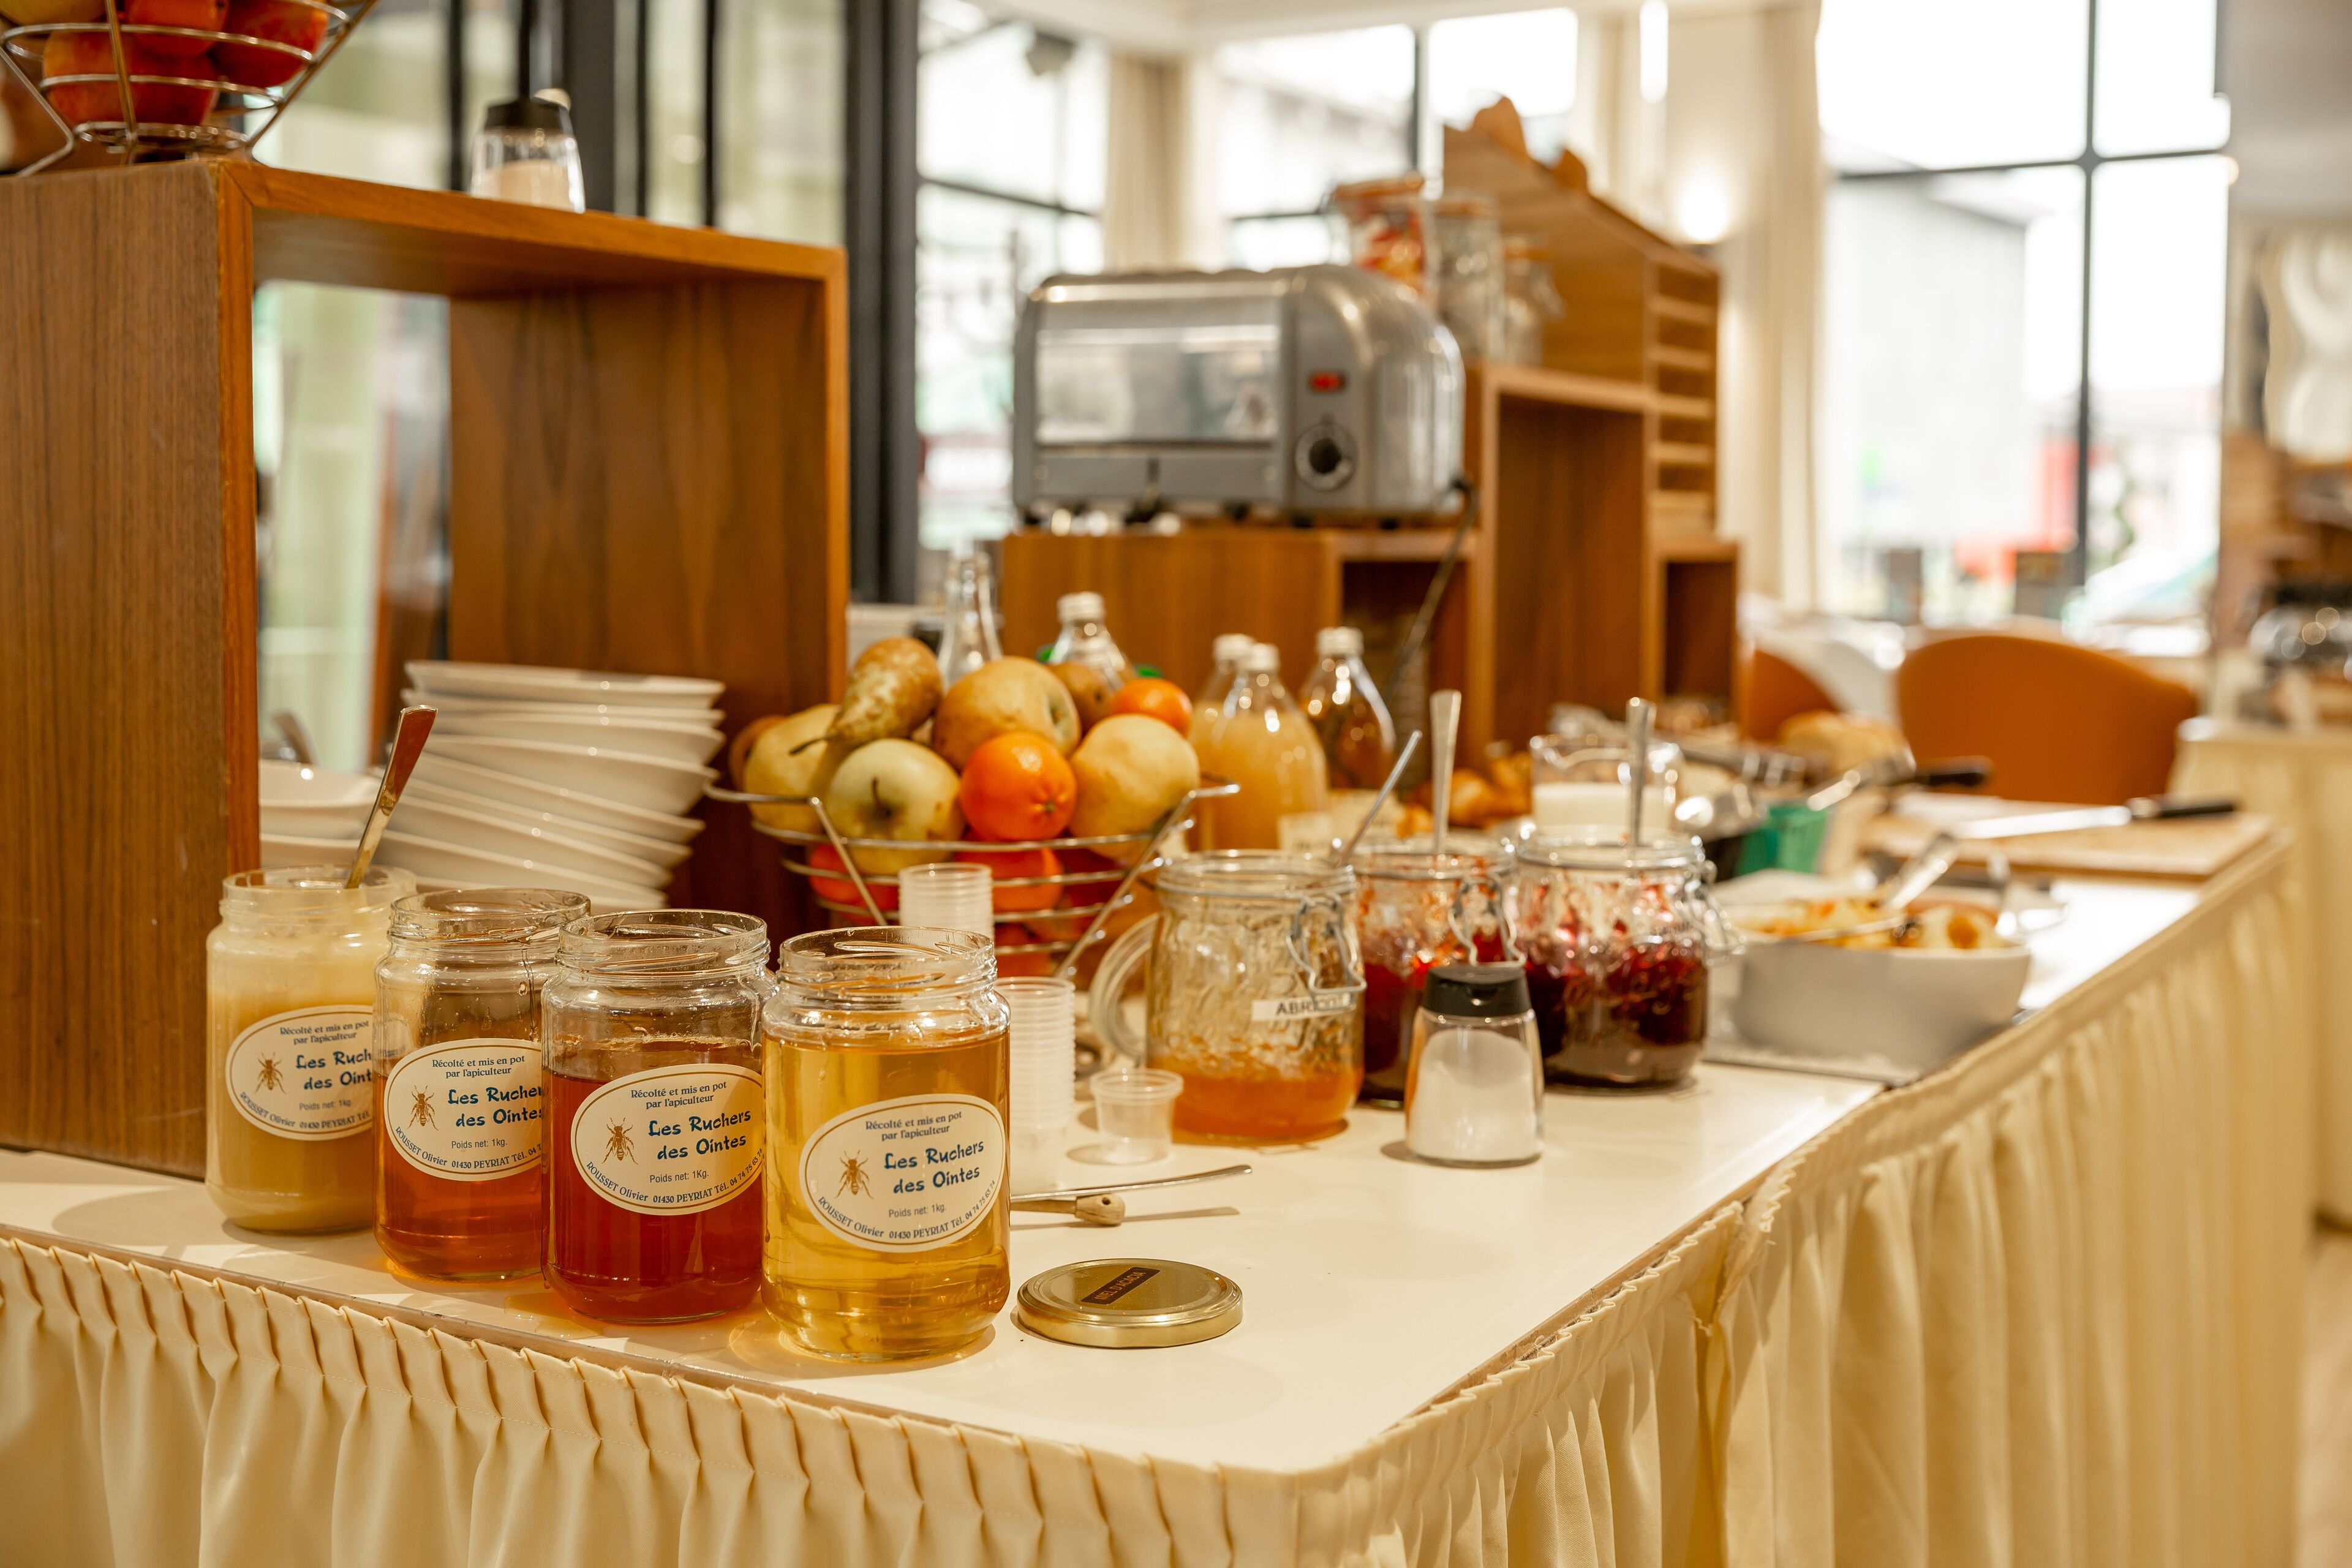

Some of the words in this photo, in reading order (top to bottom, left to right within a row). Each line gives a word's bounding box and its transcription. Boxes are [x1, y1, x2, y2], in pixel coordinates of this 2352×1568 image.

[280, 1026, 312, 1036] Récolté
[326, 1023, 341, 1033] mis
[355, 1020, 369, 1030] pot
[293, 1037, 307, 1046] par
[295, 1054, 326, 1069] Les
[432, 1058, 464, 1068] Récolté
[478, 1058, 494, 1066] mis
[510, 1055, 526, 1065] pot
[445, 1071, 460, 1079] par
[463, 1067, 512, 1078] l'apiculteur
[303, 1076, 333, 1090] des
[631, 1088, 666, 1098] Récolté
[669, 1088, 678, 1096] et
[681, 1085, 698, 1095] mis
[699, 1084, 710, 1093] en
[712, 1081, 727, 1092] pot
[447, 1088, 478, 1105] Les
[646, 1100, 662, 1110] par
[664, 1094, 714, 1108] l'apiculteur
[456, 1113, 485, 1128] des
[648, 1120, 682, 1137] Les
[688, 1110, 752, 1132] Ruchers
[865, 1119, 902, 1130] Récolté
[918, 1116, 933, 1126] mis
[935, 1114, 946, 1123] en
[948, 1111, 962, 1123] pot
[881, 1132, 897, 1142] par
[900, 1125, 951, 1140] l'apiculteur
[396, 1126, 421, 1156] ROUSSET
[421, 1150, 447, 1166] Olivier
[451, 1160, 472, 1169] 01430
[473, 1155, 510, 1169] PEYRIAT
[511, 1151, 527, 1163] Tél.
[528, 1147, 537, 1156] 04
[451, 1140, 472, 1149] Poids
[475, 1139, 489, 1148] net:
[491, 1137, 508, 1147] 1kg.
[657, 1145, 688, 1160] des
[696, 1134, 747, 1155] Ointes
[884, 1153, 918, 1169] Les
[925, 1141, 984, 1164] Ruchers
[586, 1161, 619, 1192] ROUSSET
[619, 1186, 649, 1202] Olivier
[652, 1194, 674, 1204] 01430
[676, 1188, 713, 1204] PEYRIAT
[714, 1182, 729, 1193] Tél.
[729, 1177, 738, 1187] 04
[737, 1171, 746, 1180] 74
[745, 1164, 753, 1174] 75
[752, 1157, 760, 1167] 63
[649, 1173, 673, 1183] Poids
[674, 1171, 690, 1182] net:
[692, 1168, 709, 1180] 1Kg.
[893, 1178, 925, 1194] des
[932, 1166, 980, 1188] Ointes
[818, 1196, 853, 1227] ROUSSET
[854, 1222, 884, 1238] Olivier
[889, 1230, 911, 1239] 01430
[913, 1222, 949, 1238] PEYRIAT
[949, 1216, 965, 1229] Tél.
[965, 1210, 973, 1220] 04
[971, 1204, 979, 1213] 74
[978, 1196, 986, 1207] 75
[984, 1188, 992, 1198] 63
[989, 1180, 996, 1190] 74
[888, 1208, 911, 1218] Poids
[914, 1206, 929, 1216] net:
[932, 1203, 947, 1214] 1kg.
